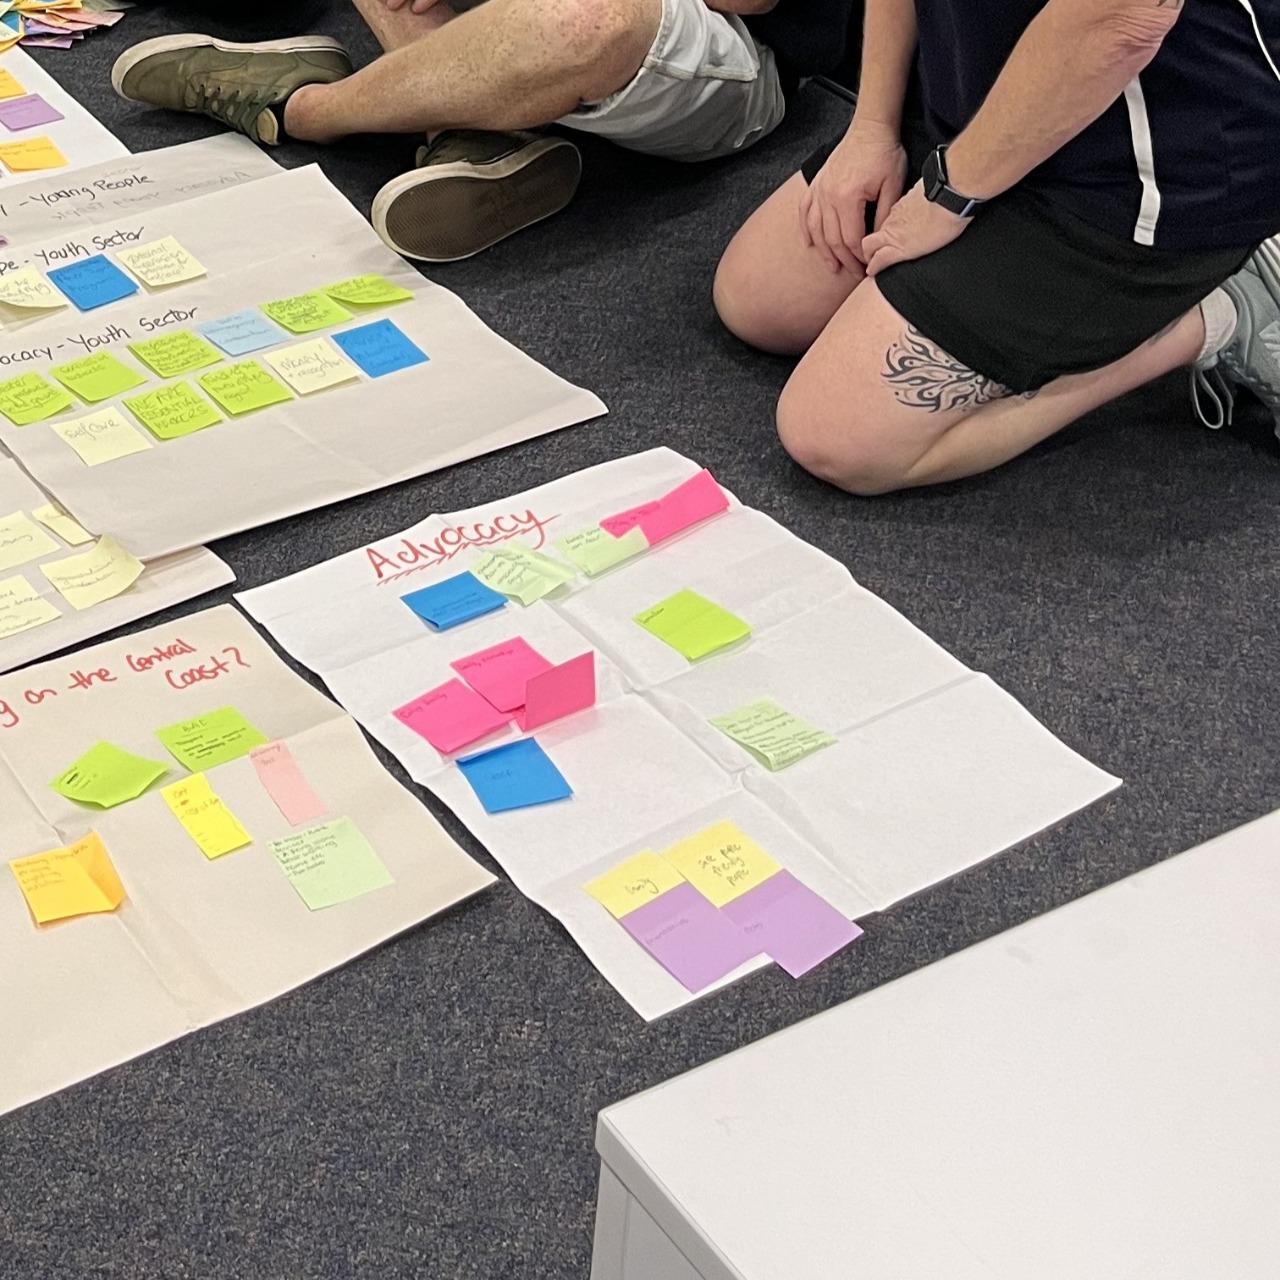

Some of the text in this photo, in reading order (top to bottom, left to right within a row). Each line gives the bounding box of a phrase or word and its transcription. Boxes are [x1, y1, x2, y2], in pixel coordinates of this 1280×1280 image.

[93, 173, 155, 193] People
[34, 243, 90, 266] Youth
[91, 227, 148, 252] Sector
[66, 323, 132, 354] Youth
[138, 306, 199, 332] Sector
[365, 509, 561, 580] Advocacy
[23, 686, 59, 706] on
[67, 664, 119, 696] the
[126, 639, 199, 675] Central
[164, 645, 252, 692] Coast?
